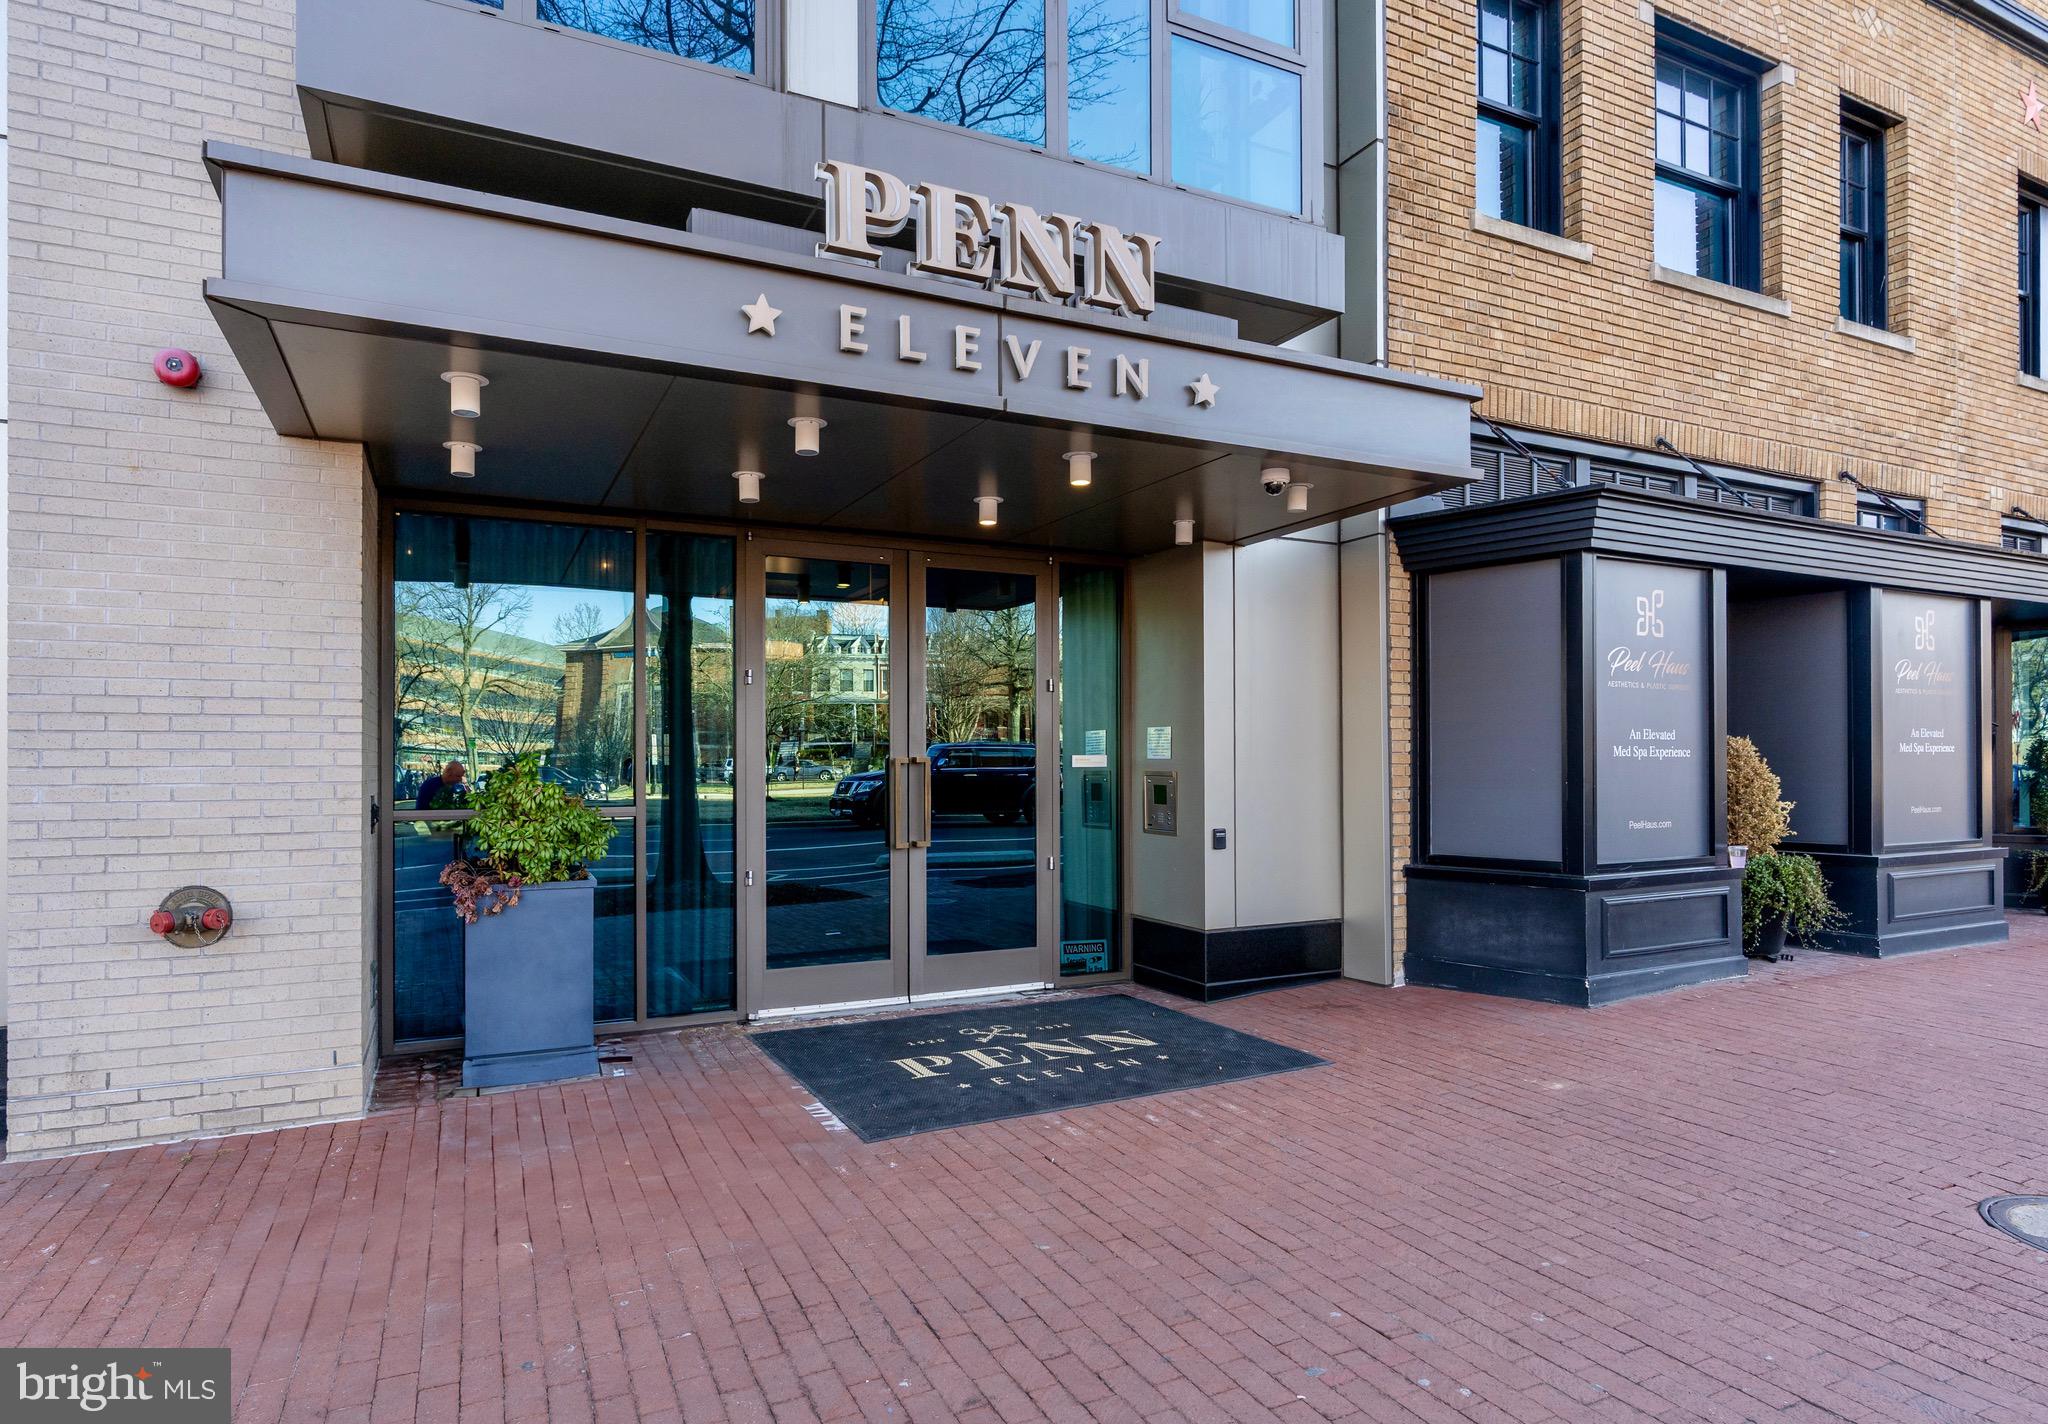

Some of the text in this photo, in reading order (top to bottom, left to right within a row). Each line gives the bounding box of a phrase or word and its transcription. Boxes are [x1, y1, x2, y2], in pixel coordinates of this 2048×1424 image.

[814, 159, 1161, 320] PENN
[839, 304, 1150, 399] ELEVEN
[1608, 646, 1690, 679] Peel Haus
[1895, 659, 1923, 685] Peel
[1607, 680, 1639, 688] AESTHETICS
[1630, 729, 1676, 741] An Elevated
[1910, 728, 1944, 738] An Elevated
[1613, 746, 1691, 760] Med Spa Experience
[1899, 743, 1955, 755] Med Spa Experience
[1629, 820, 1672, 830] PeelHaus.com
[1065, 943, 1103, 954] WARNING
[887, 1030, 1159, 1080] PENN
[990, 1058, 1142, 1086] ELEVEN
